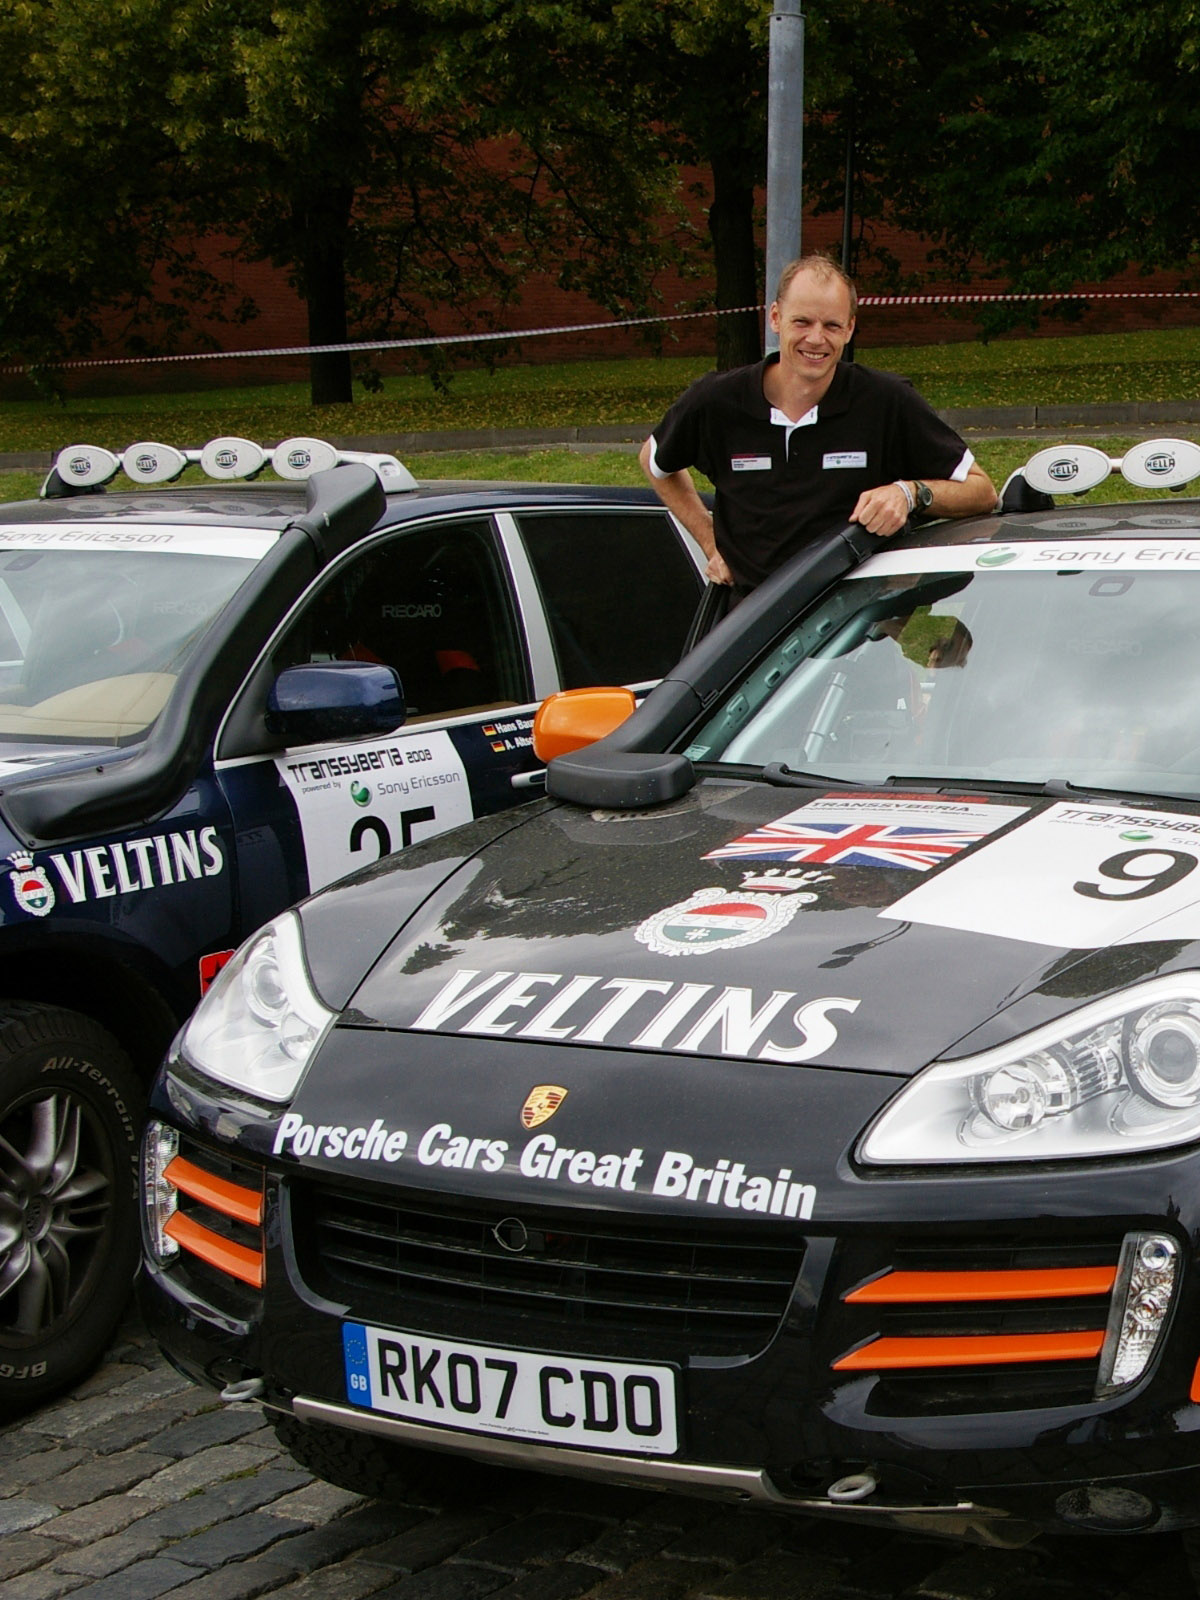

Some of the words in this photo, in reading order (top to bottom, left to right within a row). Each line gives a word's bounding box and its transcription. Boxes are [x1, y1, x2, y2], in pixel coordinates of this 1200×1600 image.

[1050, 460, 1080, 480] HELLA
[1147, 454, 1176, 474] HELLA
[0, 531, 56, 544] Sony
[60, 531, 174, 544] Ericsson
[1033, 549, 1129, 564] Sony
[382, 604, 442, 618] RECARO
[494, 722, 517, 733] Hans
[504, 739, 515, 750] A.
[287, 747, 404, 783] Transsyberia
[407, 749, 433, 764] 2008
[302, 782, 331, 794] powered
[333, 780, 342, 789] by
[377, 782, 410, 796] Sony
[411, 771, 461, 790] Ericsson
[812, 802, 971, 813] TRANSSYBERIA
[49, 826, 225, 903] VELTINS
[1073, 848, 1199, 901] 9
[408, 968, 861, 1064] VELTINS
[40, 1056, 135, 1142] All-Terrain
[272, 1112, 408, 1161] Porsche
[416, 1122, 508, 1173] Cars
[519, 1133, 644, 1191] Great
[651, 1150, 817, 1221] Britain
[351, 1373, 368, 1391] GB
[377, 1337, 518, 1419] RK07
[538, 1365, 663, 1437] CDO
